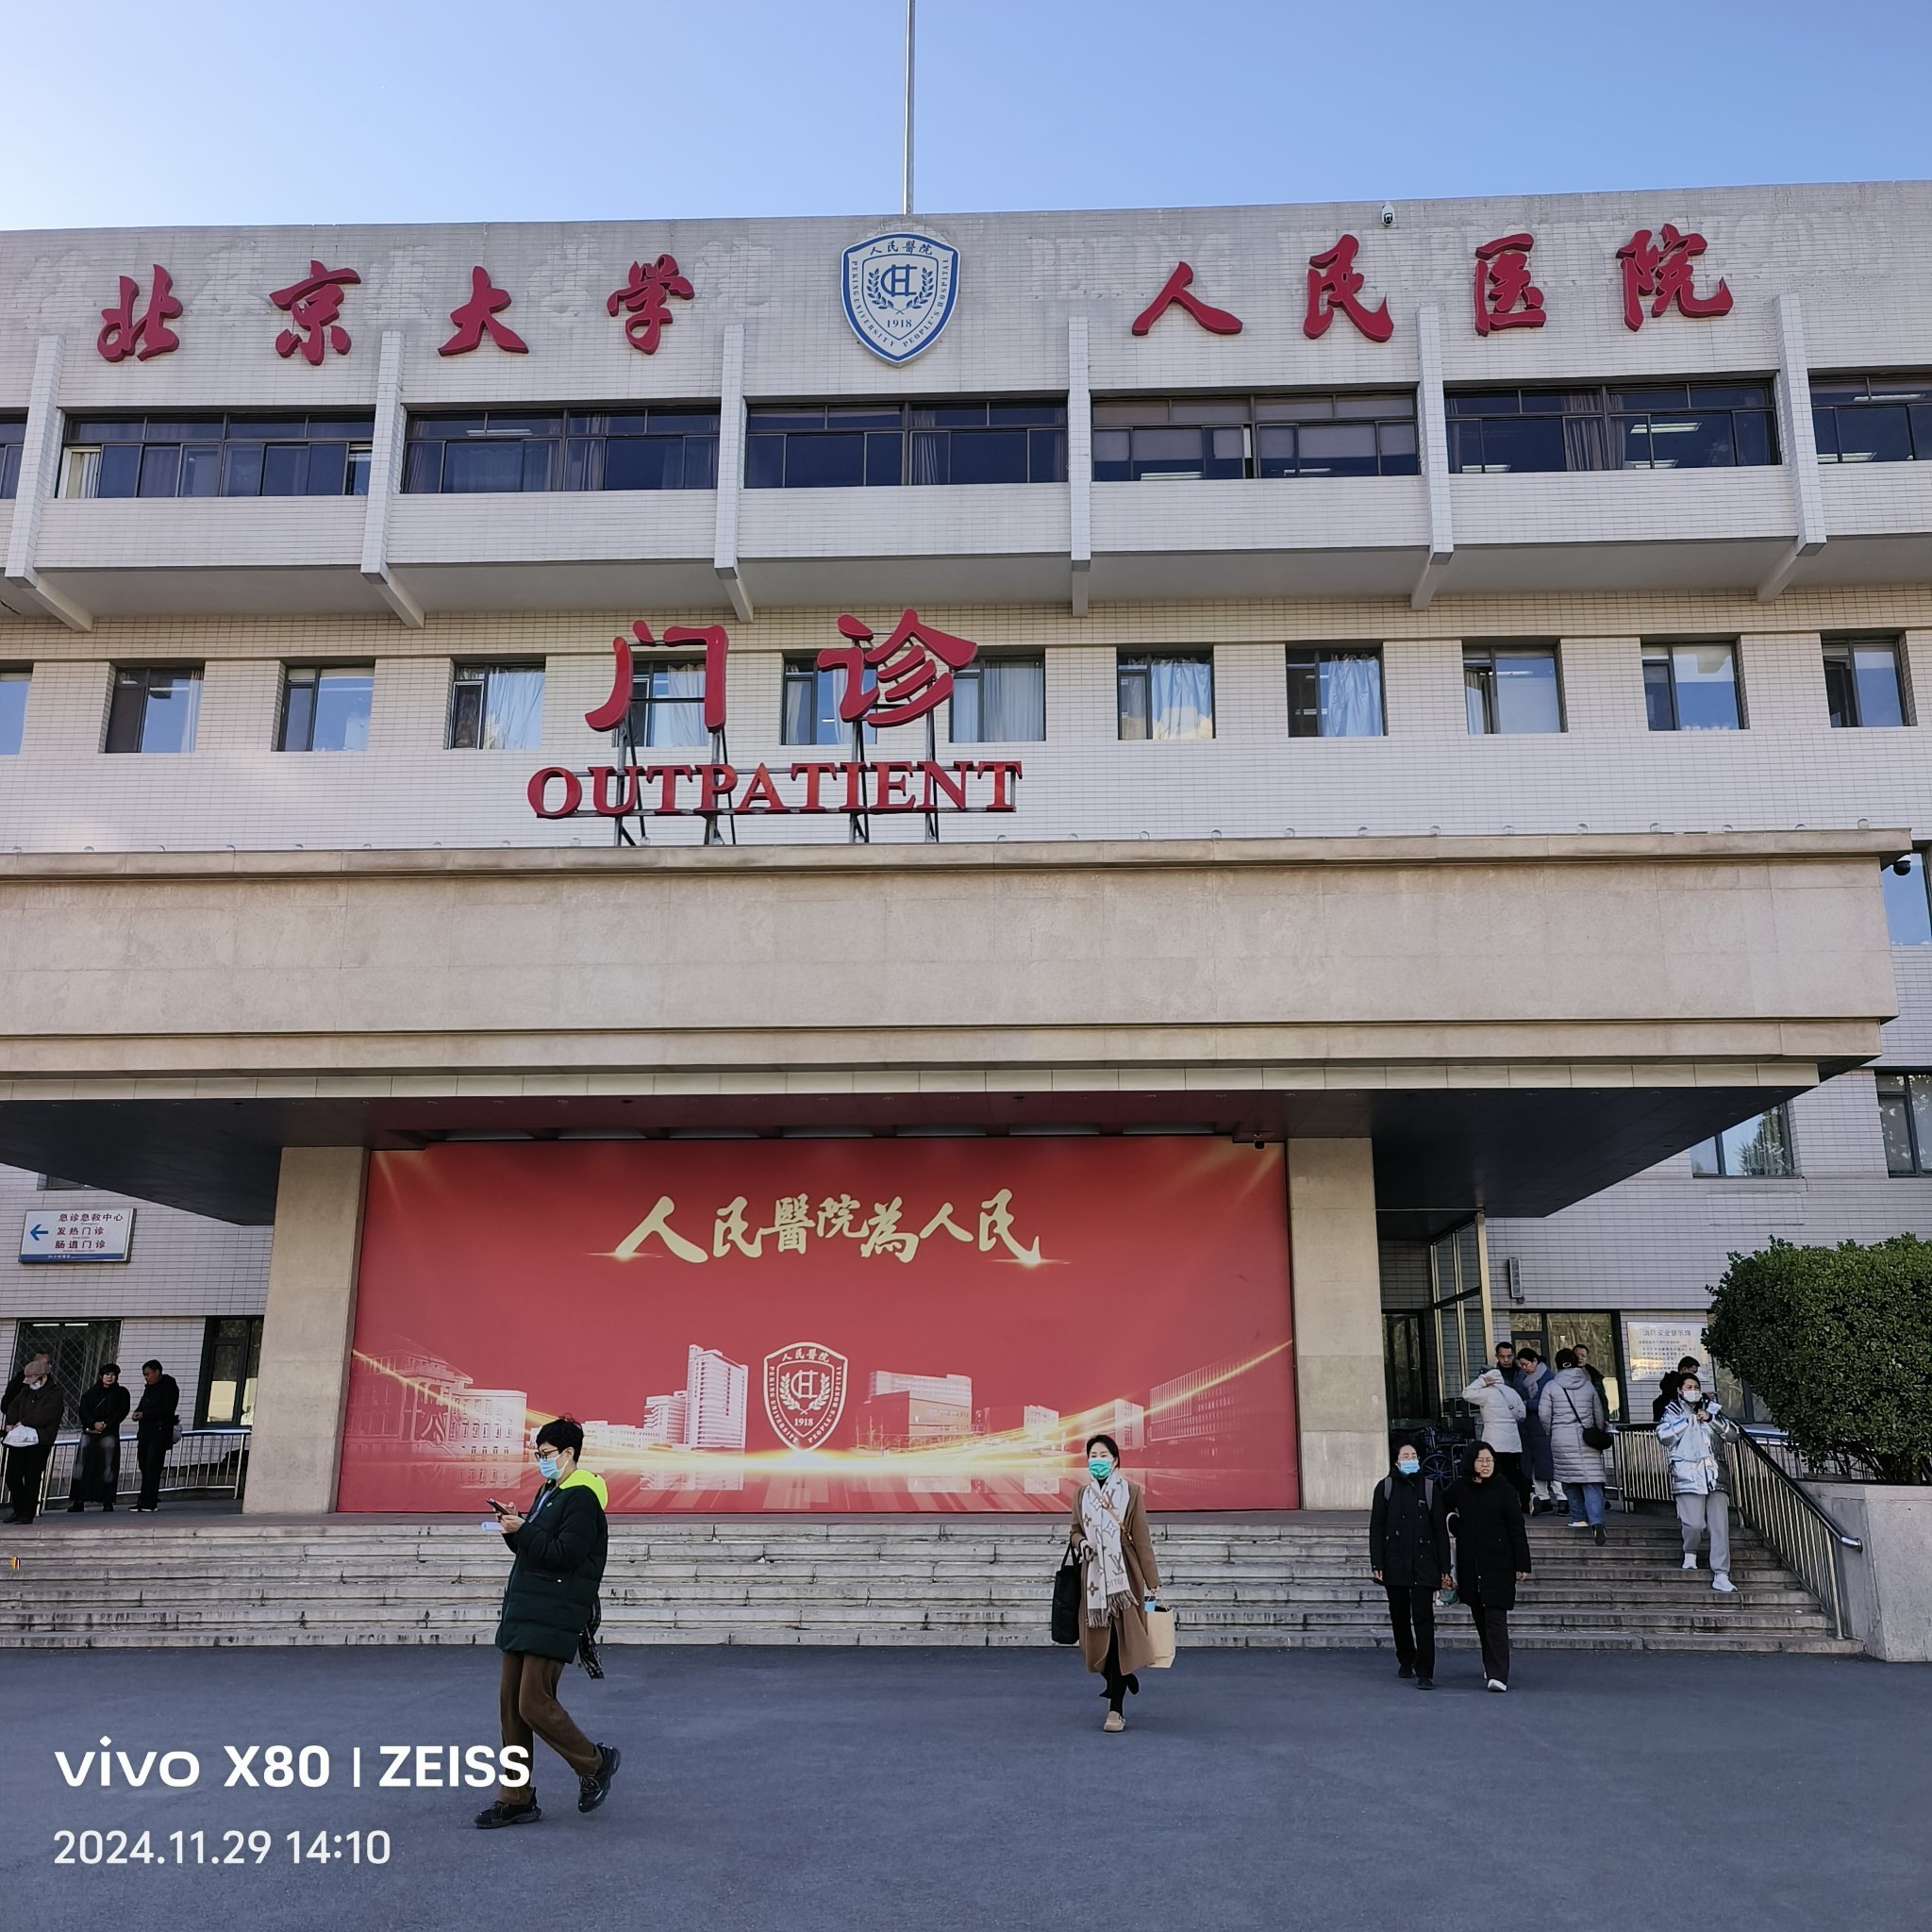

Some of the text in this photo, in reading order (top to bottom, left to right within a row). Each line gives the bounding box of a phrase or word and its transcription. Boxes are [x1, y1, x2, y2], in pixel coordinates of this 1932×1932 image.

[870, 240, 933, 256] 人民醫院
[97, 254, 695, 366] 北京大学
[1131, 223, 1734, 342] 人民医院
[887, 319, 912, 328] 1918
[584, 607, 979, 733] 门诊
[526, 759, 1024, 819] OUTPATIENT
[58, 1213, 124, 1223] 急诊急救中心
[57, 1226, 105, 1236] 发热门诊
[614, 1188, 1041, 1264] 人民醫院為人民
[55, 1240, 107, 1249] 肠道门诊
[794, 1418, 813, 1426] 1918
